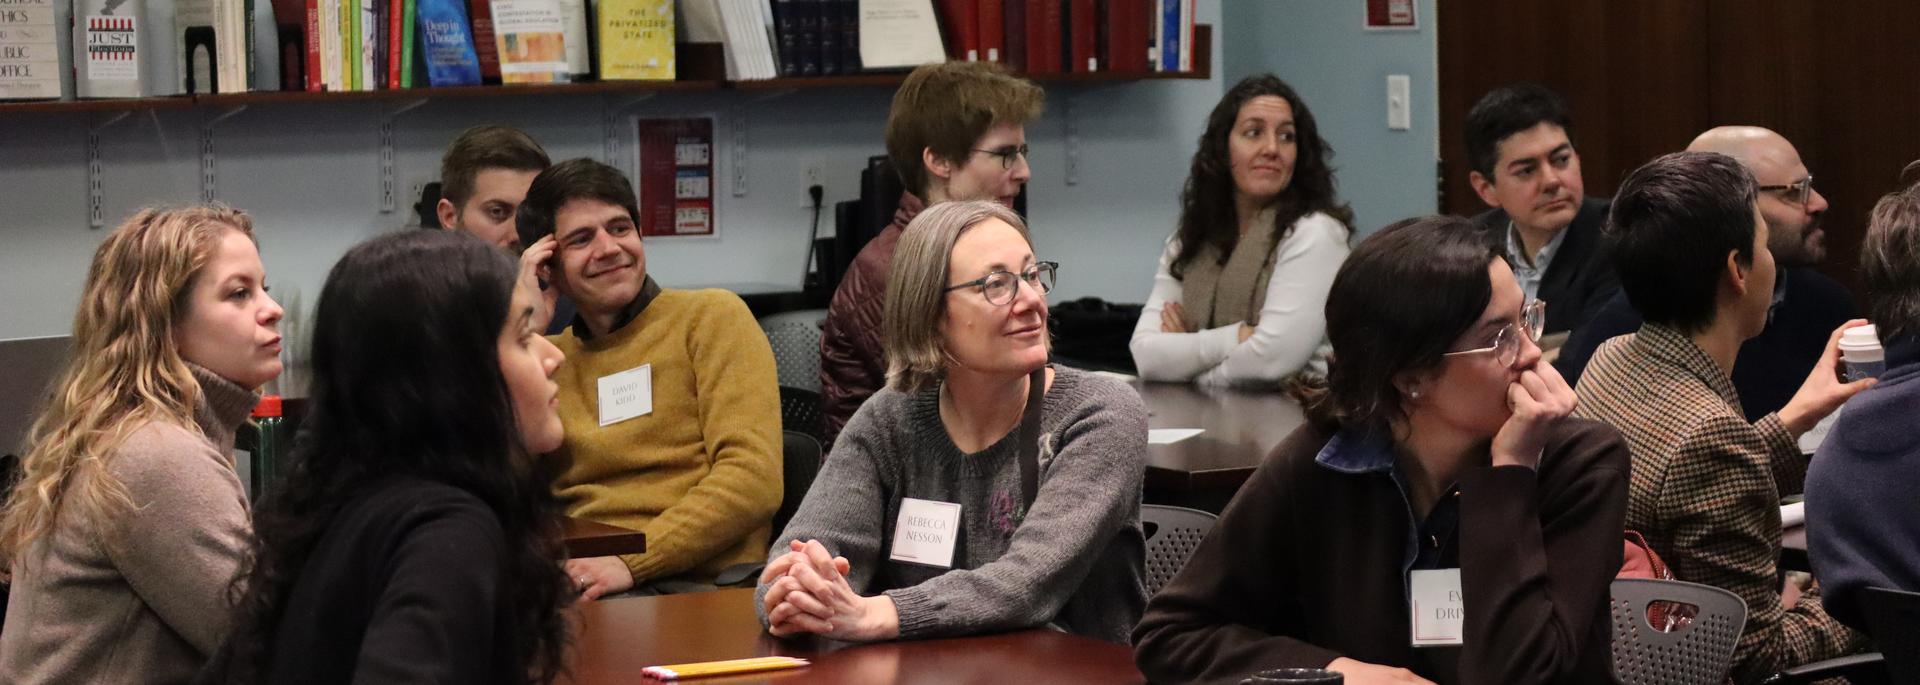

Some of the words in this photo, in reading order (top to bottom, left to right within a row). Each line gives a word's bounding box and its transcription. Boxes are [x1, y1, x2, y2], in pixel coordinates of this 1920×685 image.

[0, 10, 29, 23] HICS
[609, 19, 667, 29] PRIVATIZED
[89, 33, 134, 44] JUST
[623, 30, 653, 39] STATE
[612, 383, 638, 396] DAVID
[615, 394, 636, 406] KIDD
[907, 515, 946, 530] REBECCA
[905, 531, 943, 544] NESSON
[1448, 590, 1462, 602] EV
[1436, 607, 1464, 620] DRI
